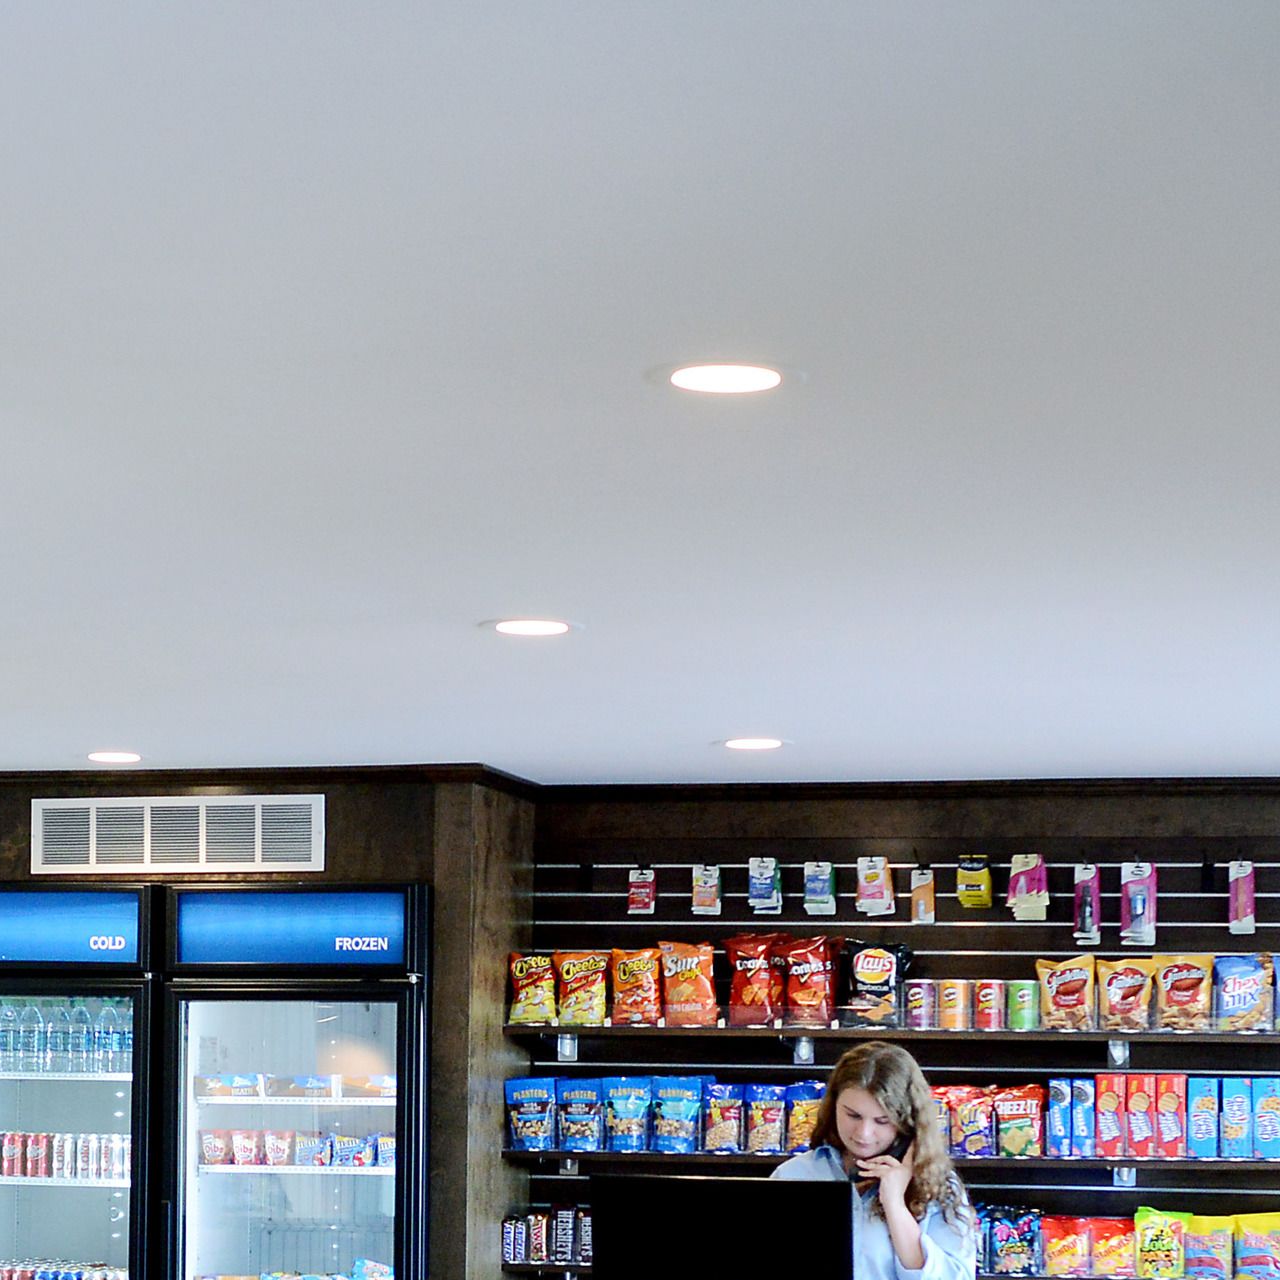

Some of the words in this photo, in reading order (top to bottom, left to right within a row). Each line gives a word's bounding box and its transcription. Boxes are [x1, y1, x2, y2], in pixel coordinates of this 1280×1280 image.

[89, 936, 126, 951] COLD
[335, 937, 388, 951] FROZEN
[560, 955, 608, 982] Cheetos
[664, 955, 701, 978] Sun
[1222, 974, 1260, 994] Chex
[1223, 990, 1260, 1010] mix
[556, 1210, 574, 1260] HERSHEY'S
